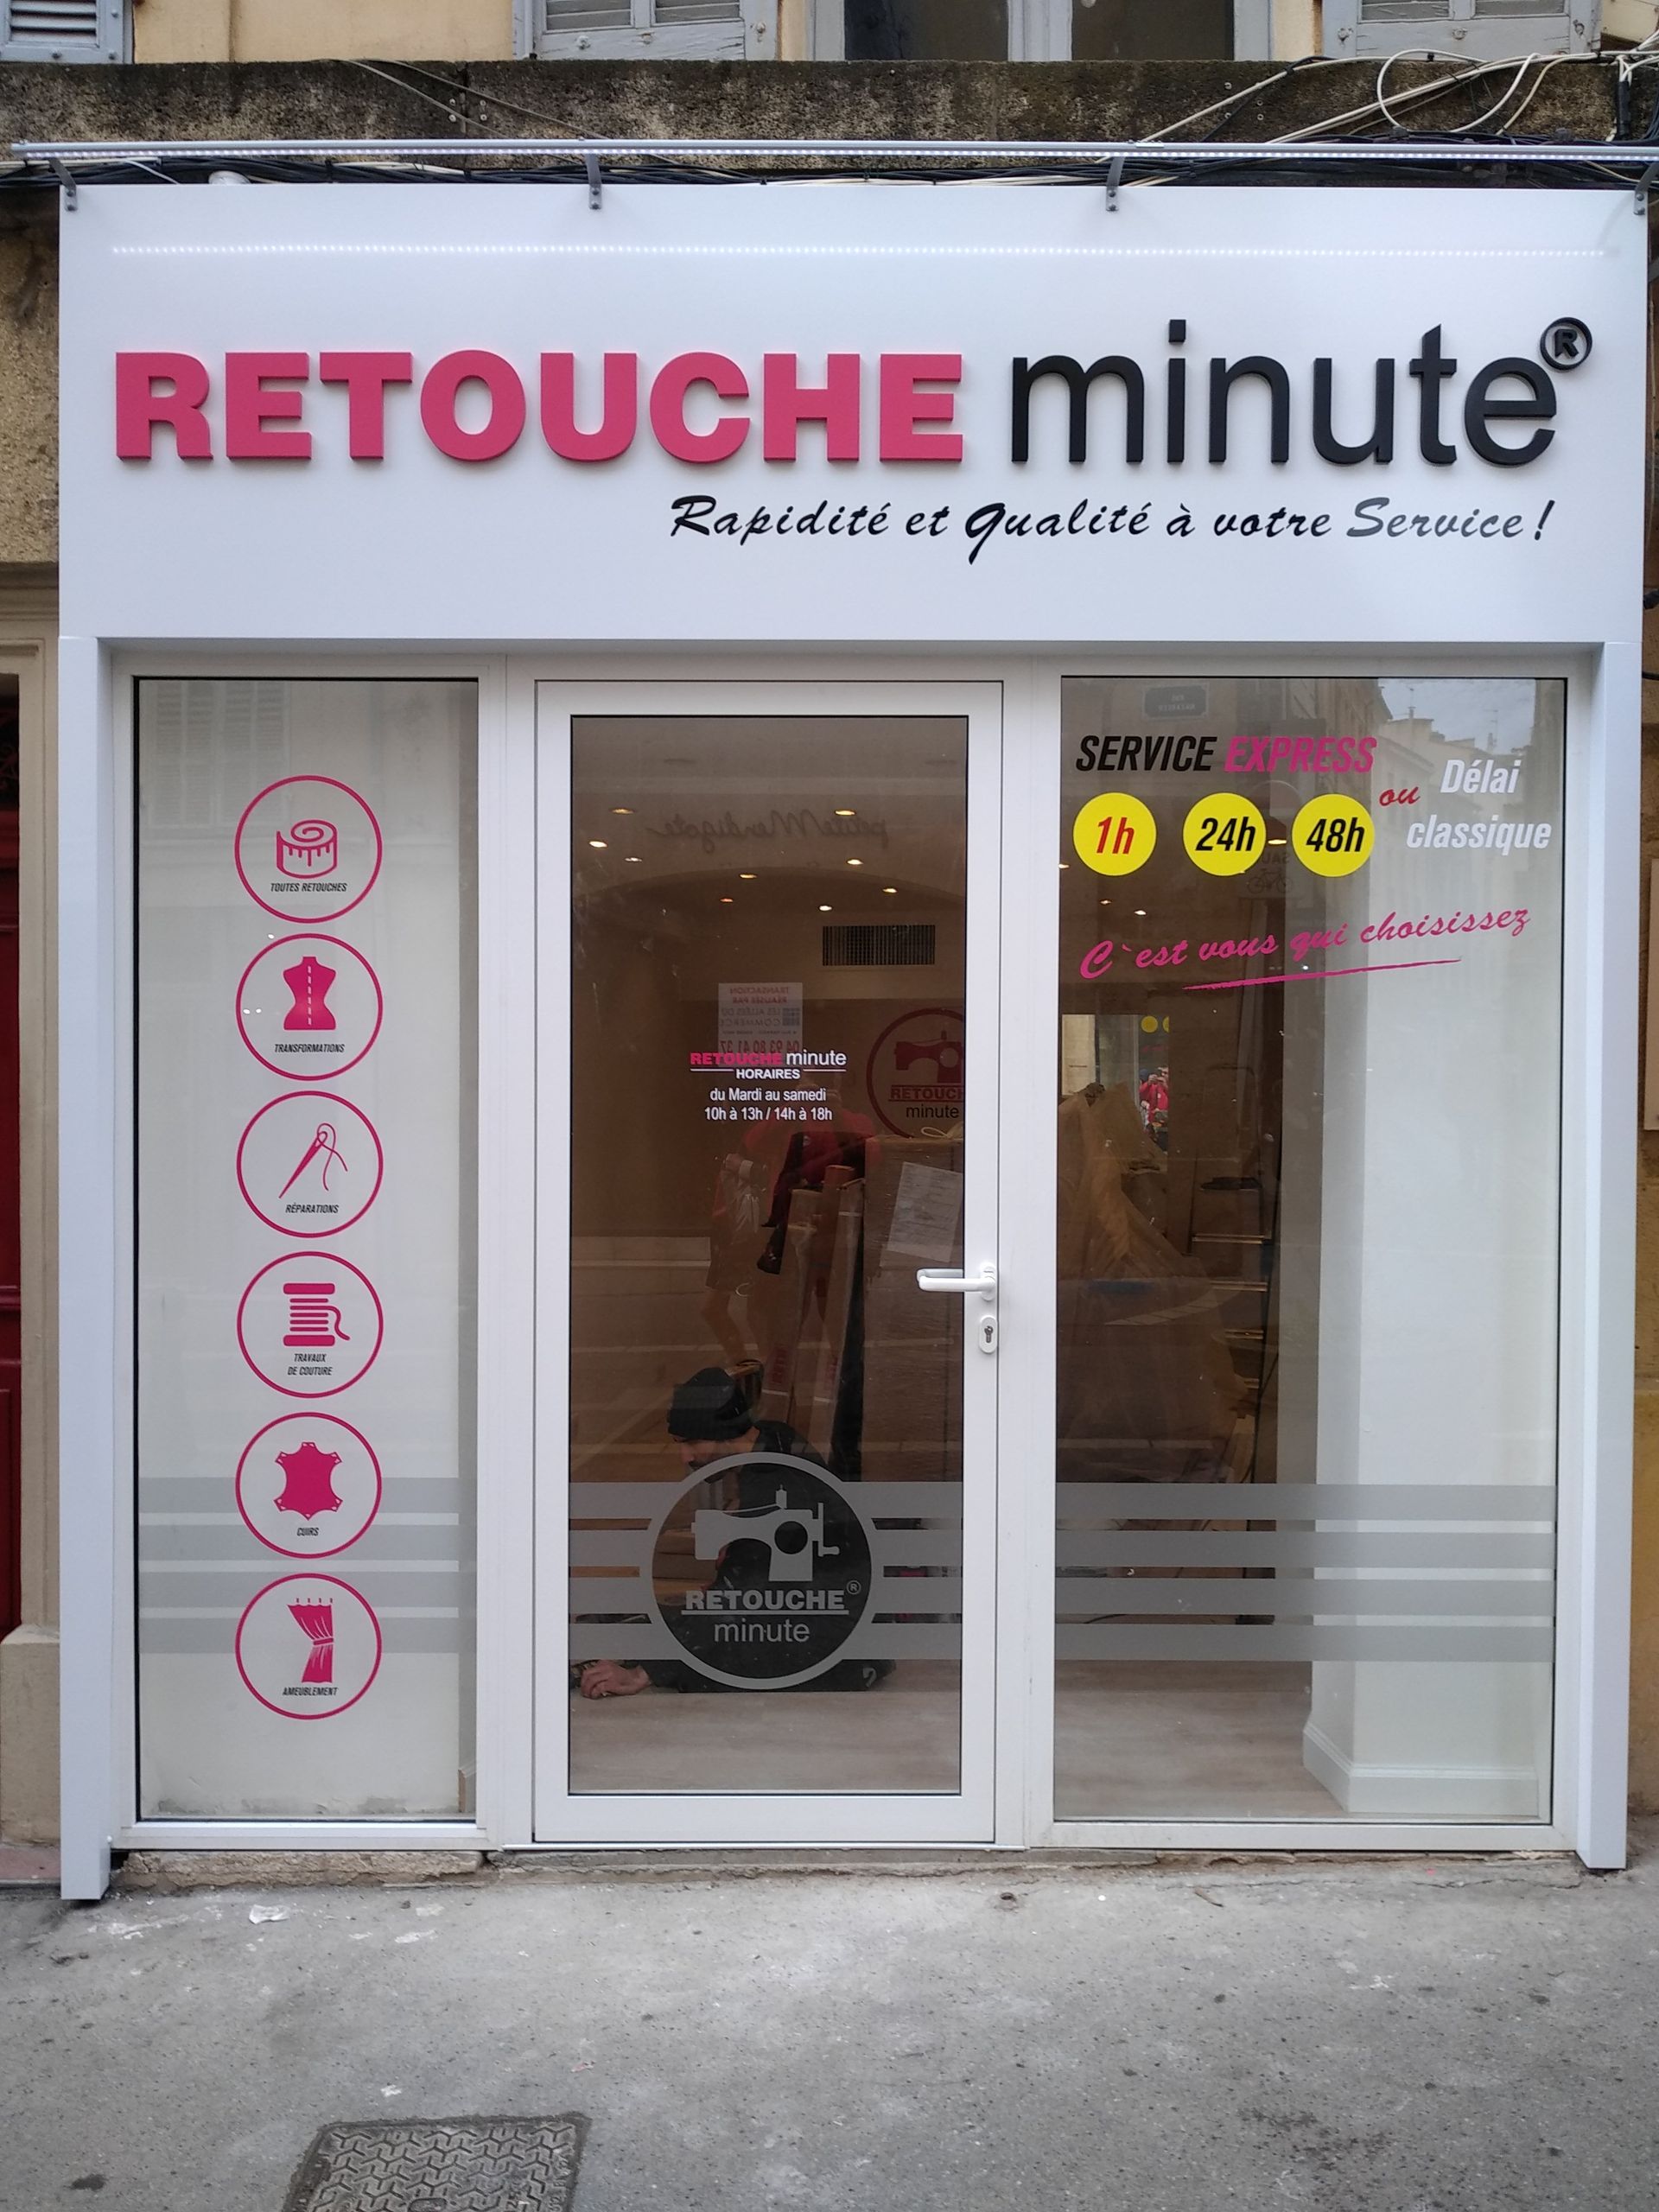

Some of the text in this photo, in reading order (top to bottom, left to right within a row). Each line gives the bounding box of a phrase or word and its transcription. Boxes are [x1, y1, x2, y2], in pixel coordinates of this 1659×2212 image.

[116, 350, 963, 464] RETOUCHE
[671, 495, 892, 546] Rapidité
[906, 506, 950, 537] et
[964, 499, 1152, 565] Qualité
[1166, 503, 1196, 537] à
[1213, 507, 1332, 538] votre
[1346, 497, 1524, 538] Service
[1076, 734, 1377, 773] SERVICE EXPRESS
[1440, 760, 1522, 794] Délai
[1379, 785, 1420, 807] ou
[1096, 816, 1135, 855] 1h
[1195, 817, 1256, 852] 24h
[1306, 817, 1366, 853] 48h
[1406, 814, 1553, 856] classique
[270, 883, 348, 893] TOUTES RETOUCHES
[1198, 934, 1279, 962] vous
[1289, 922, 1349, 962] qui
[1358, 908, 1529, 944] choisissez
[274, 1044, 345, 1053] TRANSFORMATIONS
[690, 1049, 847, 1066] RETOUCHE minute
[736, 1068, 801, 1079] HORAIRES
[709, 1087, 827, 1101] du Mardi au samedi
[704, 1107, 833, 1121] 10h à 13h / 14h à 18h
[906, 1103, 959, 1119] minute
[285, 1203, 339, 1214] RÉPARATIONS
[294, 1353, 327, 1363] TRAVAUX
[287, 1366, 334, 1376] DE COUTURE
[296, 1528, 320, 1536] CUIRS
[685, 1589, 844, 1610] RETOUCHE
[714, 1618, 810, 1643] minute
[283, 1688, 338, 1696] AMEUBLEMENT
